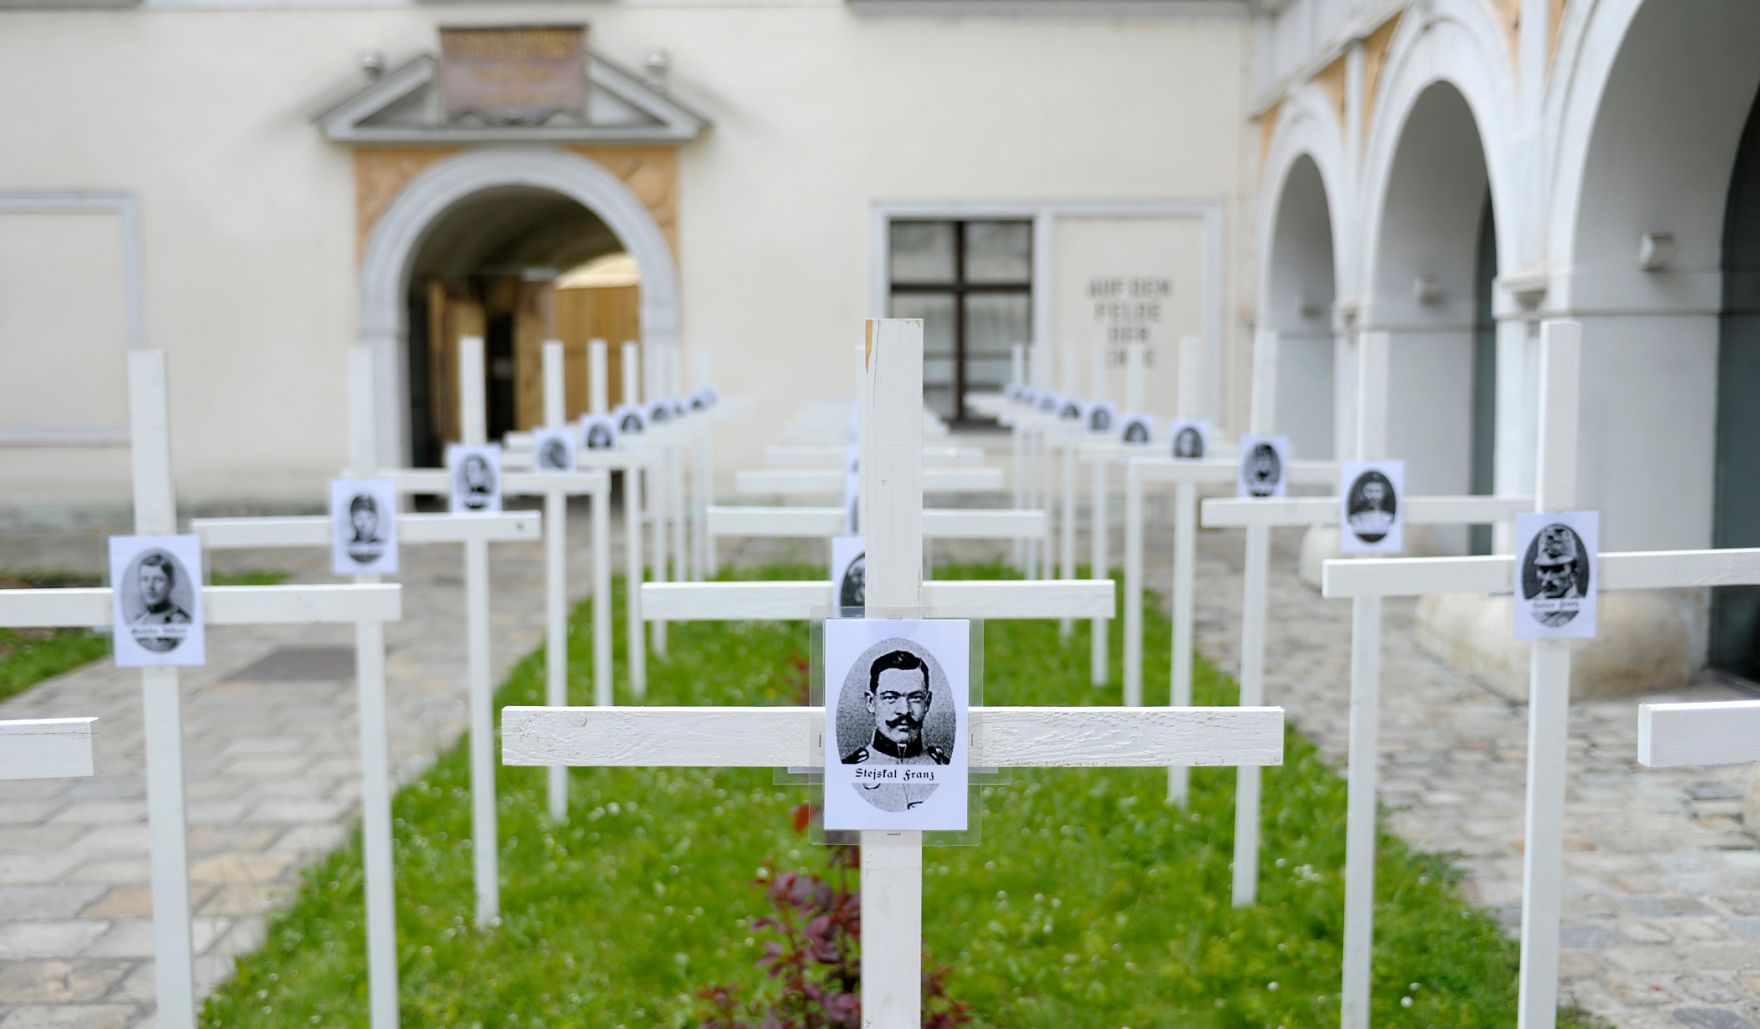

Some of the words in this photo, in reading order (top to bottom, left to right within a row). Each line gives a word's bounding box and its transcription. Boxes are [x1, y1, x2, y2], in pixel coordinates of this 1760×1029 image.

[1087, 277, 1123, 298] AUF
[855, 768, 897, 780] Stejskal
[903, 769, 935, 781] Franz
